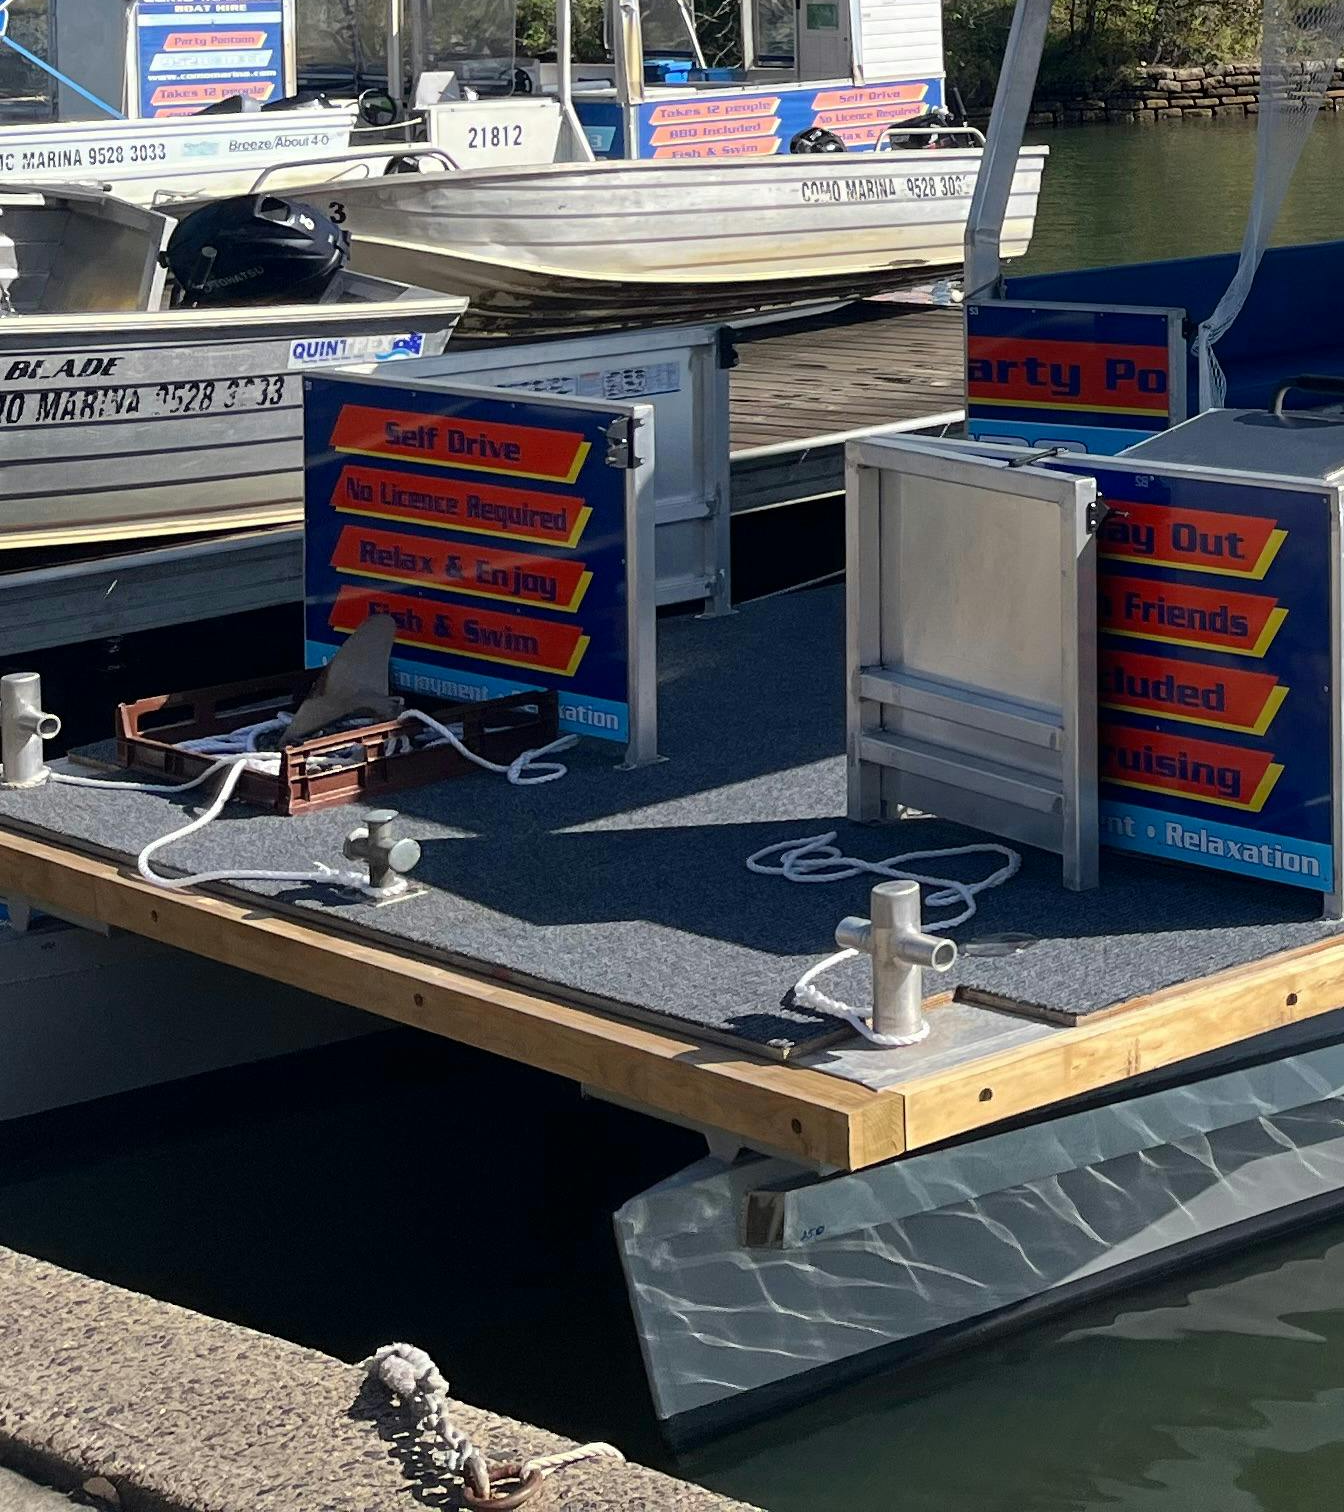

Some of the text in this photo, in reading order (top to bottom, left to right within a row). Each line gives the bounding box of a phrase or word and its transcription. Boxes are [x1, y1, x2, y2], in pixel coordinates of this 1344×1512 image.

[659, 106, 700, 119] Takes
[725, 100, 772, 116] people
[468, 125, 522, 148] 21812
[703, 122, 761, 136] Included
[22, 150, 83, 170] MARINA
[89, 146, 125, 166] 9528
[130, 143, 167, 162] 3033
[845, 178, 896, 202] MARINA
[906, 178, 937, 199] 9528
[329, 202, 346, 224] 3
[4, 357, 125, 381] BLADE
[384, 421, 521, 463] Self Drive
[345, 476, 568, 533] No Licence Required
[1170, 522, 1246, 560] Out
[359, 539, 558, 602] Relax & Enjoy
[1123, 590, 1250, 637] Friends
[433, 614, 451, 638] &
[463, 619, 539, 656] Swim
[1163, 821, 1321, 877] Relaxation
